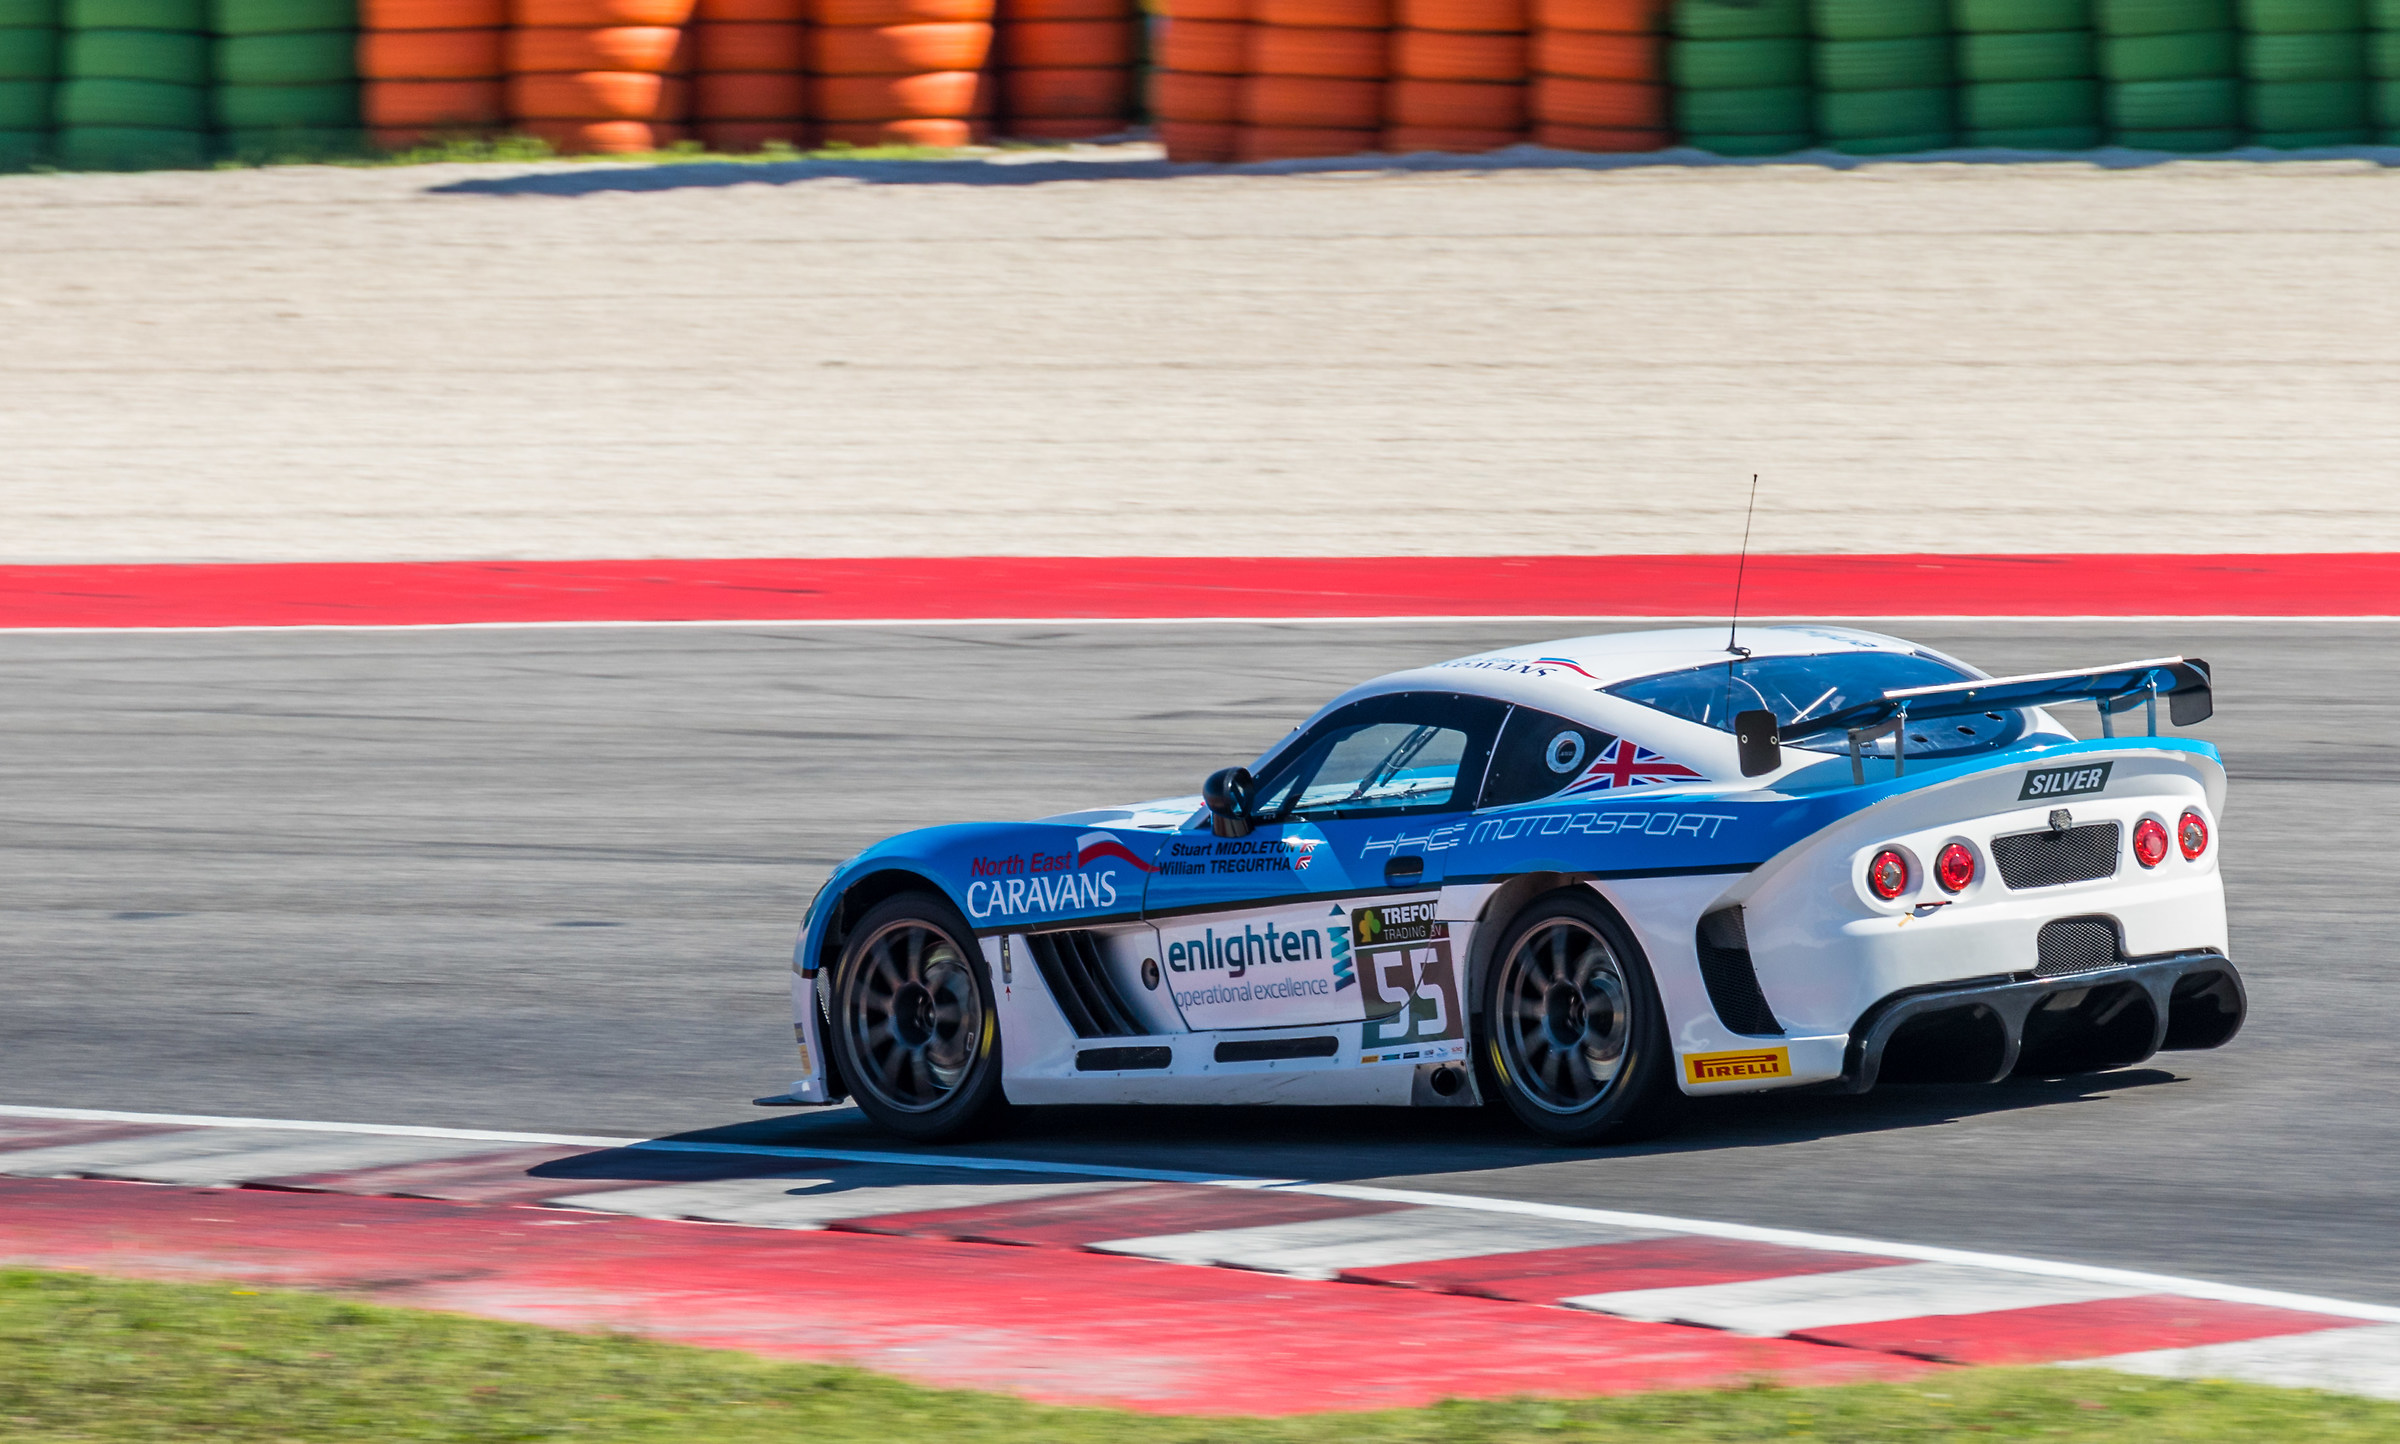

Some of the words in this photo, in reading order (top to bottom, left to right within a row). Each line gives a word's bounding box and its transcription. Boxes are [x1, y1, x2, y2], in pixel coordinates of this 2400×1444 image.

[2029, 768, 2103, 795] SILVER
[1468, 812, 1738, 844] MOTORSPORT
[1171, 842, 1212, 857] Stuart
[1215, 840, 1296, 856] MIDDLETON
[971, 854, 1024, 877] North
[1030, 851, 1073, 873] East
[1159, 861, 1205, 876] William
[1210, 857, 1291, 874] TREGURTHA
[966, 870, 1117, 919] CARAVANS
[1383, 925, 1426, 941] TRADING
[1168, 921, 1322, 979] enlighten
[1175, 981, 1253, 1011] operational
[1254, 977, 1329, 1000] excellence
[1371, 947, 1448, 1040] 55
[1693, 1054, 1779, 1078] PIRELLI
